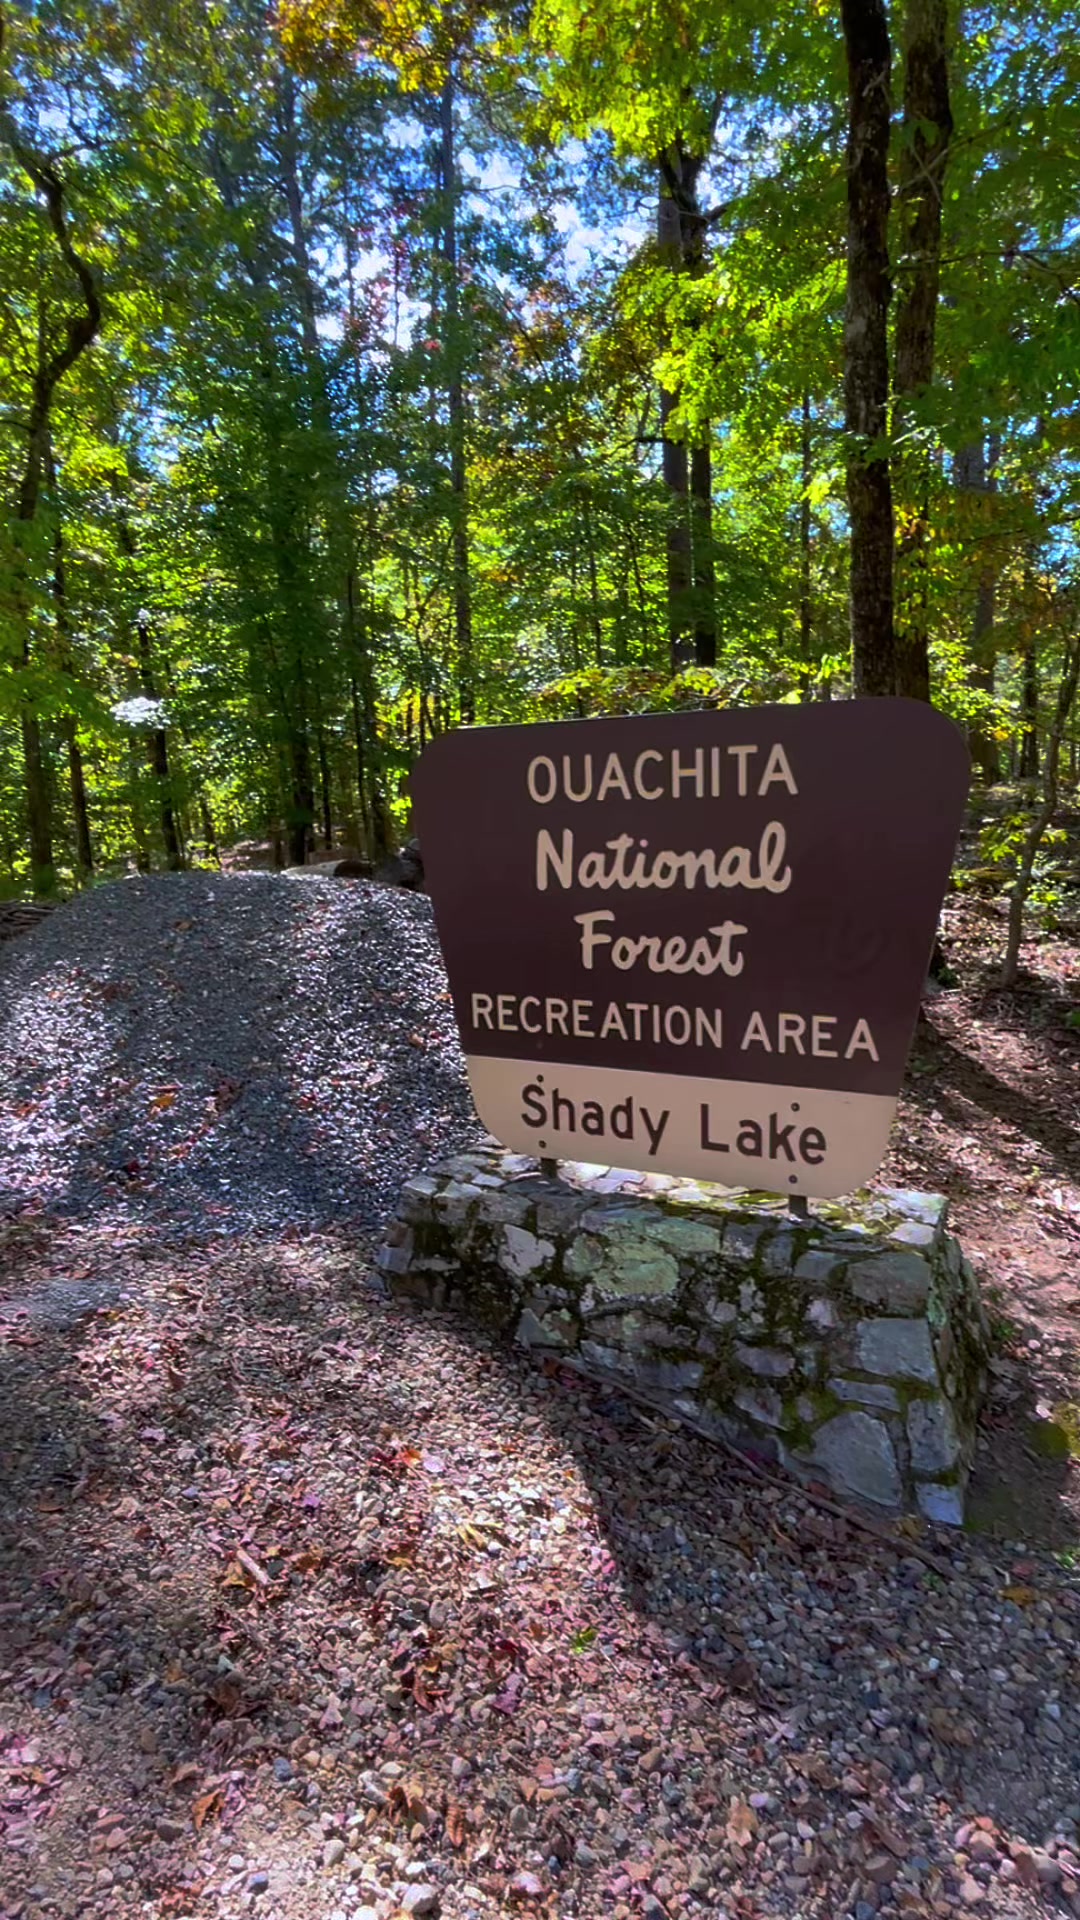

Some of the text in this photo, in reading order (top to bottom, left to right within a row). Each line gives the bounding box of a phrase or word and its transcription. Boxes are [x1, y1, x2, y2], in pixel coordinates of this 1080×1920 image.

[527, 743, 799, 804] OUACHITA
[536, 820, 793, 893] National
[574, 909, 748, 977] Forest
[471, 993, 880, 1062] RECREATION AREA
[520, 1082, 828, 1166] Shady Lake
